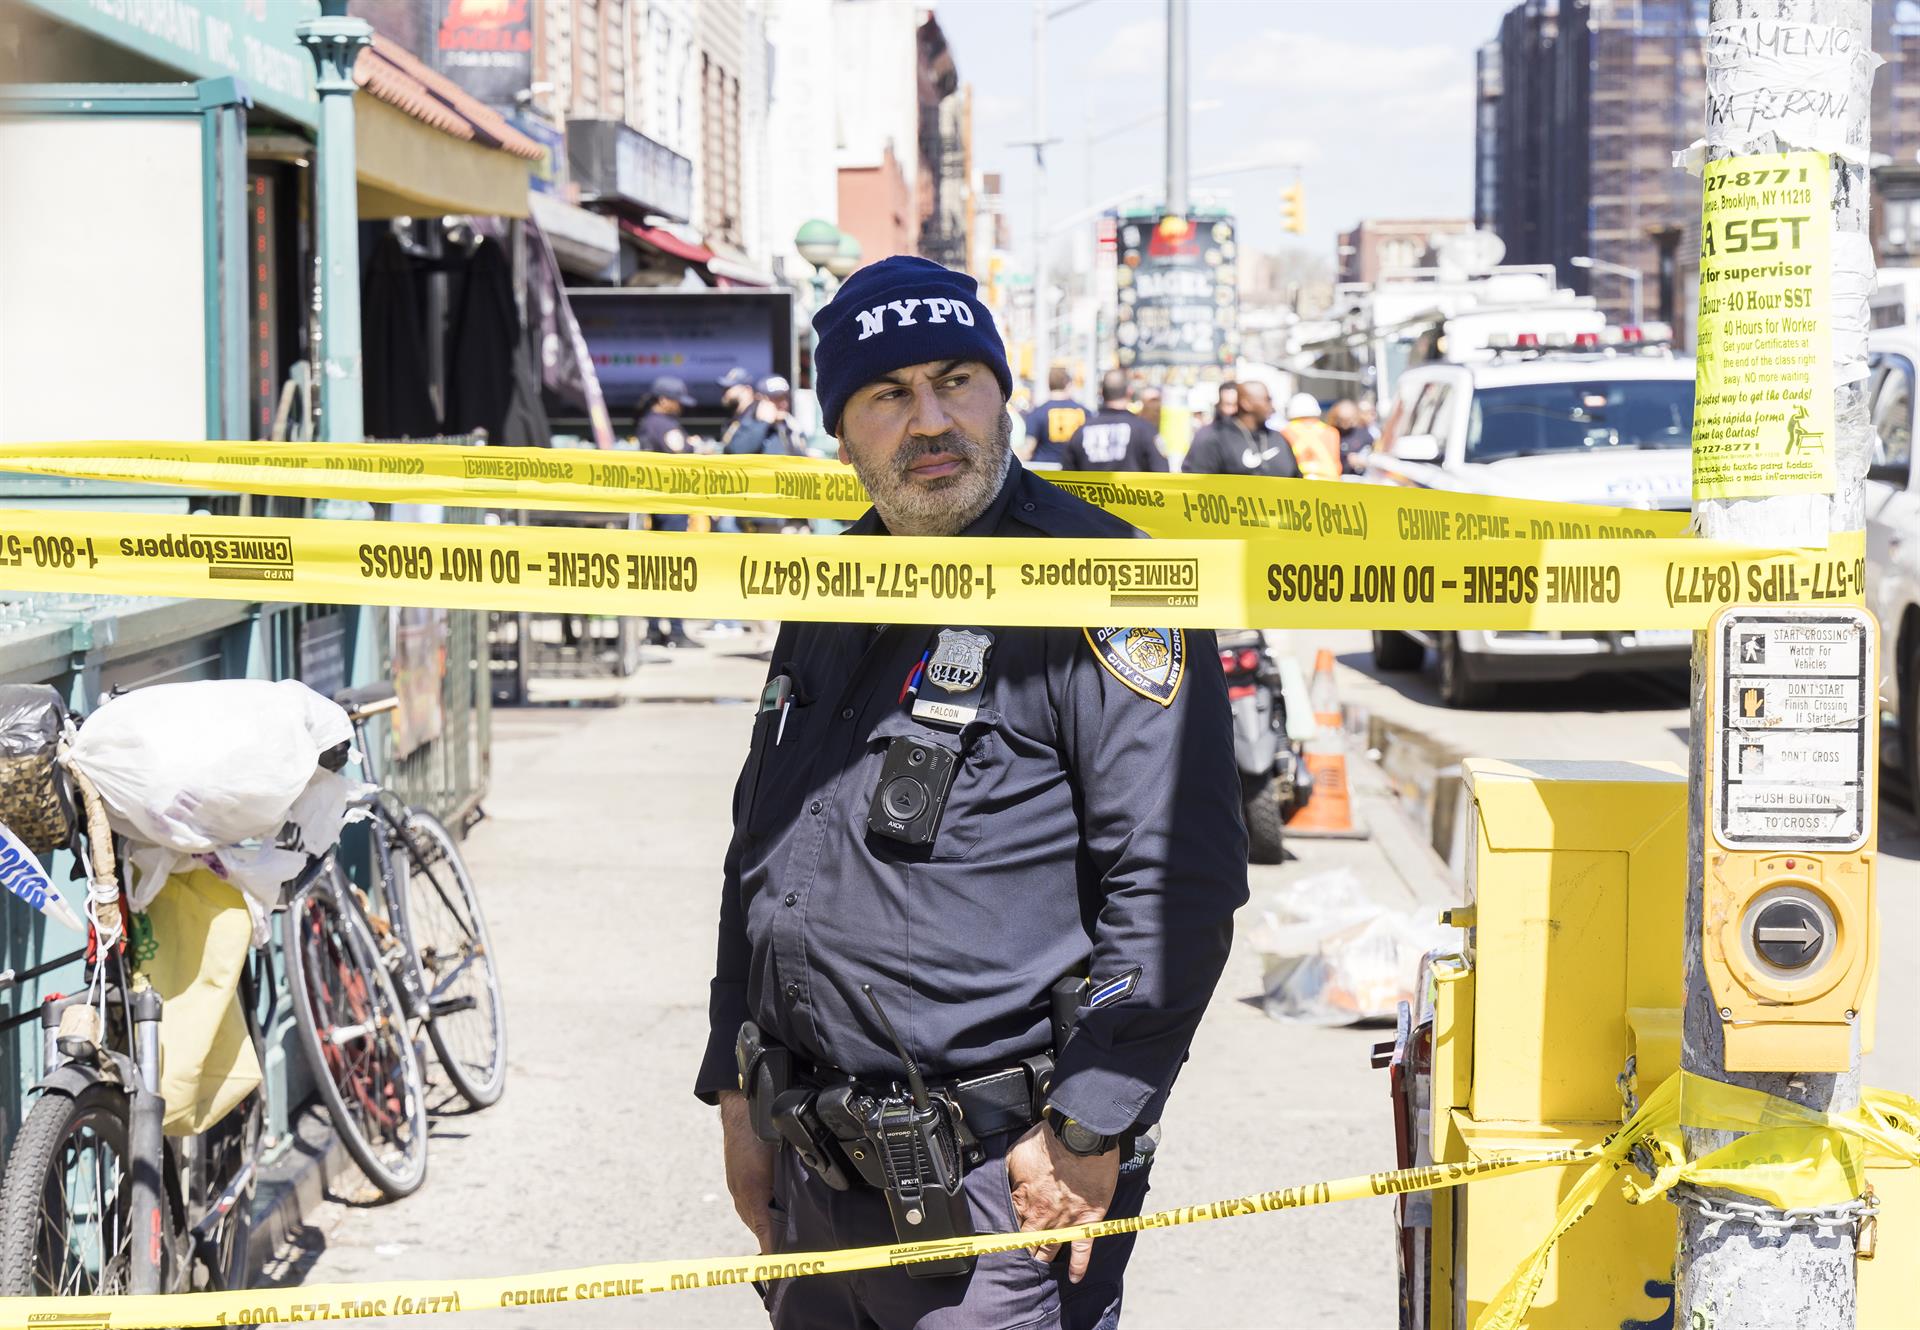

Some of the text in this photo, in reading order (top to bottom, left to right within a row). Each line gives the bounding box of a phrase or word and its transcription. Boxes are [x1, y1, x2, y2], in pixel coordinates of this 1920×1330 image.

[1721, 193, 1759, 211] Brooklyn,
[1762, 190, 1777, 206] NY
[1781, 188, 1812, 205] 11218
[1725, 216, 1812, 254] SST
[1706, 267, 1721, 283] for
[1724, 261, 1812, 282] supervisor
[1747, 291, 1782, 311] Hour
[1784, 288, 1813, 308] SST
[855, 297, 975, 340] NYPD
[1724, 316, 1817, 337] 40 Hours for Worker
[1723, 340, 1736, 352] Get
[1737, 341, 1753, 354] your
[1755, 337, 1800, 350] Certificates
[1736, 356, 1750, 367] end
[1751, 355, 1760, 367] of
[1761, 354, 1773, 366] the
[1775, 354, 1797, 366] class
[1745, 371, 1757, 384] NO
[1759, 373, 1779, 383] more
[1722, 391, 1738, 406] way
[1739, 389, 1748, 402] to
[1750, 388, 1764, 405] get
[1766, 388, 1780, 401] the
[1783, 387, 1813, 401] Cards!
[1723, 410, 1753, 427] rápida
[1755, 411, 1786, 426] forma
[1711, 427, 1724, 440] las
[1726, 425, 1761, 440] Cartas!
[1761, 463, 1784, 473] para
[1766, 470, 1824, 482] información
[358, 543, 434, 579] CROSS
[439, 546, 483, 582] NOT
[490, 548, 521, 584] DO
[548, 551, 620, 589] SCENE
[263, 568, 293, 580] NYPD
[626, 554, 698, 592] CRIME
[740, 555, 997, 601] 1-800-577-TIPS (8477)
[1267, 563, 1344, 603] CROSS
[1349, 564, 1397, 604] NOT
[1403, 564, 1435, 604] DO
[1464, 565, 1539, 604] SCENE
[1547, 566, 1621, 604] CRIME
[1666, 561, 1740, 608] (8477)
[1167, 596, 1197, 607] NYPD
[1773, 629, 1848, 641] START CROSSING
[1789, 645, 1831, 657] Watch For
[1106, 652, 1134, 676] CITY
[1133, 674, 1152, 688] OF
[1166, 660, 1182, 688] NEW
[1794, 657, 1827, 670] Vehicles
[932, 663, 977, 688] 8442
[1788, 683, 1844, 696] DON'T START
[929, 705, 960, 718] FALCON
[1785, 700, 1848, 713] Finish Crossing
[1796, 713, 1836, 724] If Started
[1781, 750, 1840, 763] DON'T CROSS
[1754, 793, 1831, 805] PUSH BUTTON
[887, 820, 905, 831] AXON
[1765, 816, 1820, 829] TO CROSS
[1370, 1166, 1443, 1196] CRIME
[1258, 1181, 1329, 1211] (8477)
[500, 1287, 568, 1307] CRIME
[575, 1279, 643, 1300] SCENE
[29, 1313, 58, 1322] NYPD
